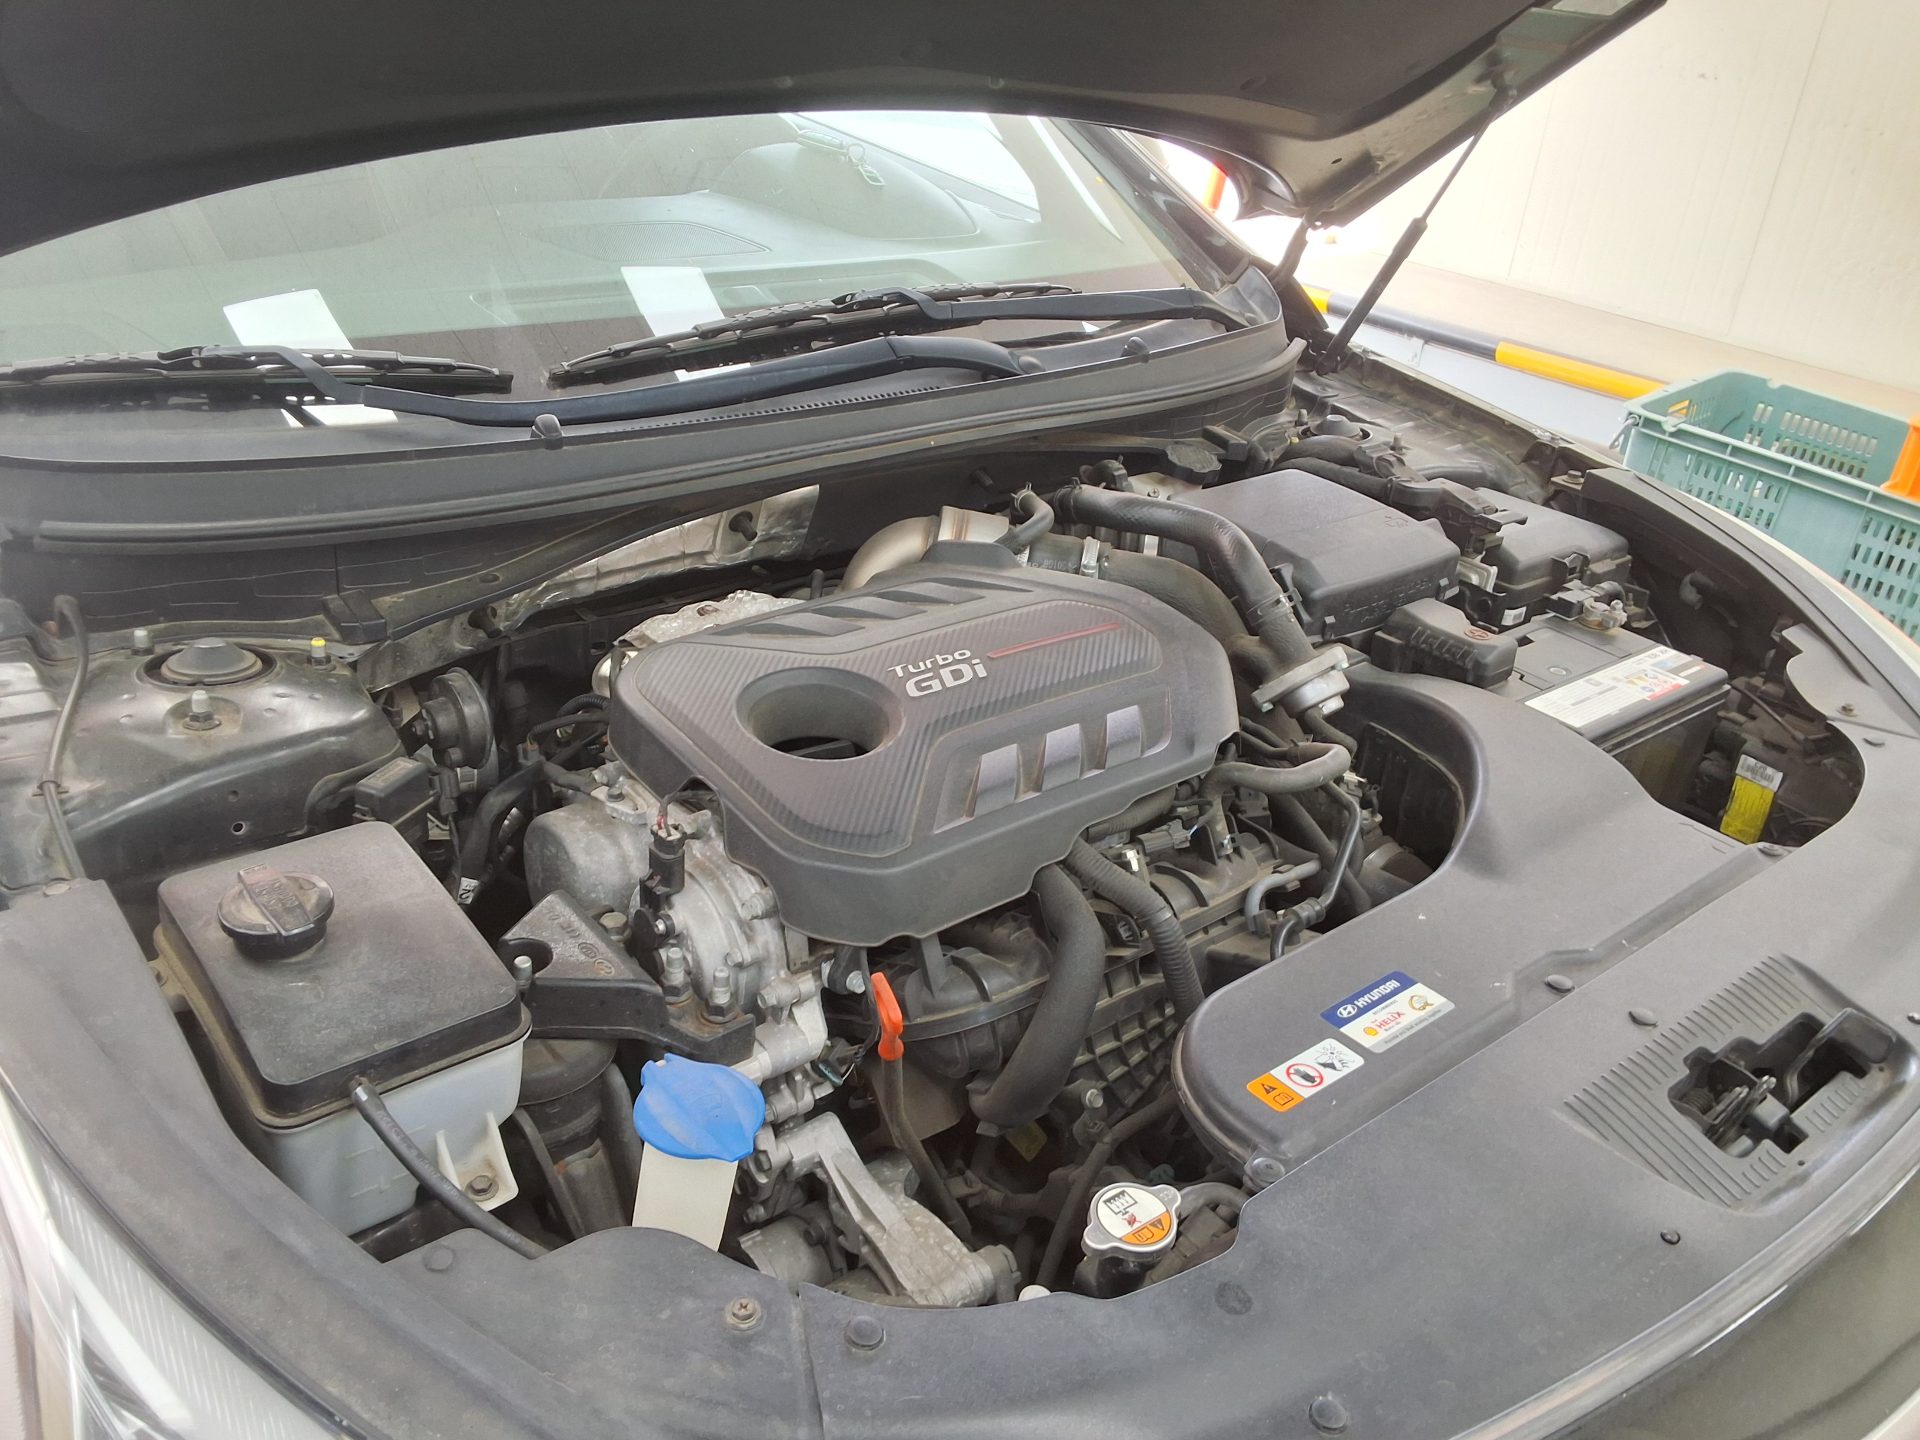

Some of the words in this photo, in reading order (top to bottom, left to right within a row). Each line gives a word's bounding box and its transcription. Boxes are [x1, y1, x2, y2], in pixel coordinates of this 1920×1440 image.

[887, 649, 971, 677] Turbo
[905, 658, 988, 697] GDi
[1354, 980, 1400, 1008] HYUNDAI
[1376, 1011, 1405, 1030] HELIX
